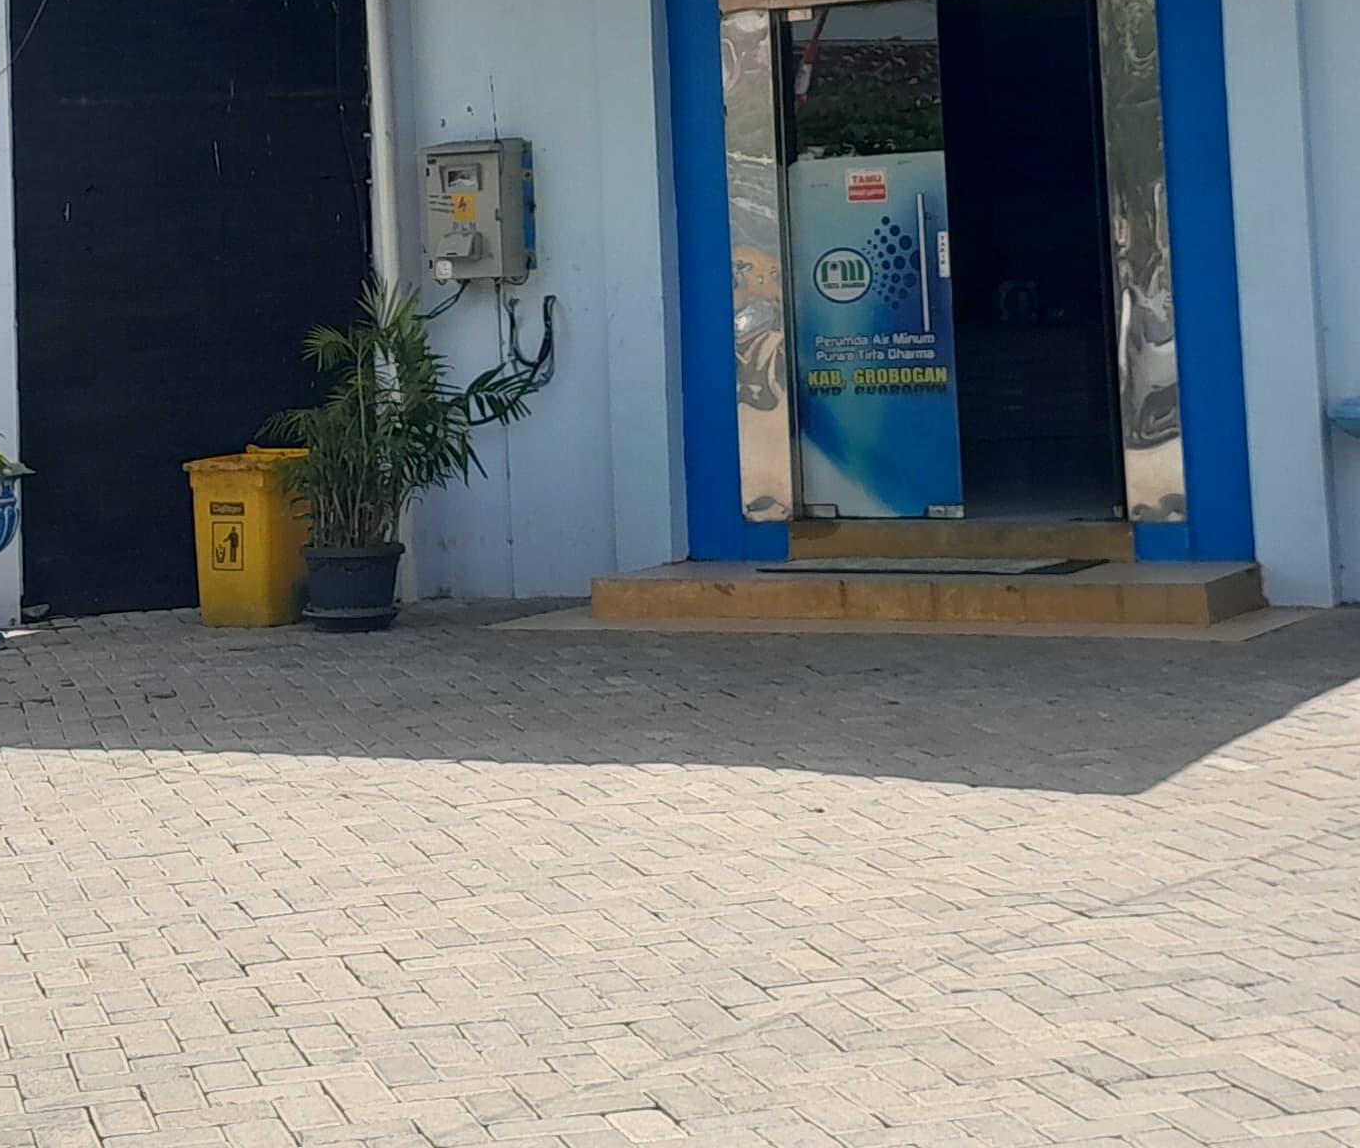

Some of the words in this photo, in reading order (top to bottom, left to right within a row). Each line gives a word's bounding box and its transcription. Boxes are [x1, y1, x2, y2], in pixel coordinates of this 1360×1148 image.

[872, 334, 890, 345] Air
[893, 332, 935, 345] Minum
[887, 349, 935, 359] Dharma
[853, 366, 948, 385] GROBOGAN
